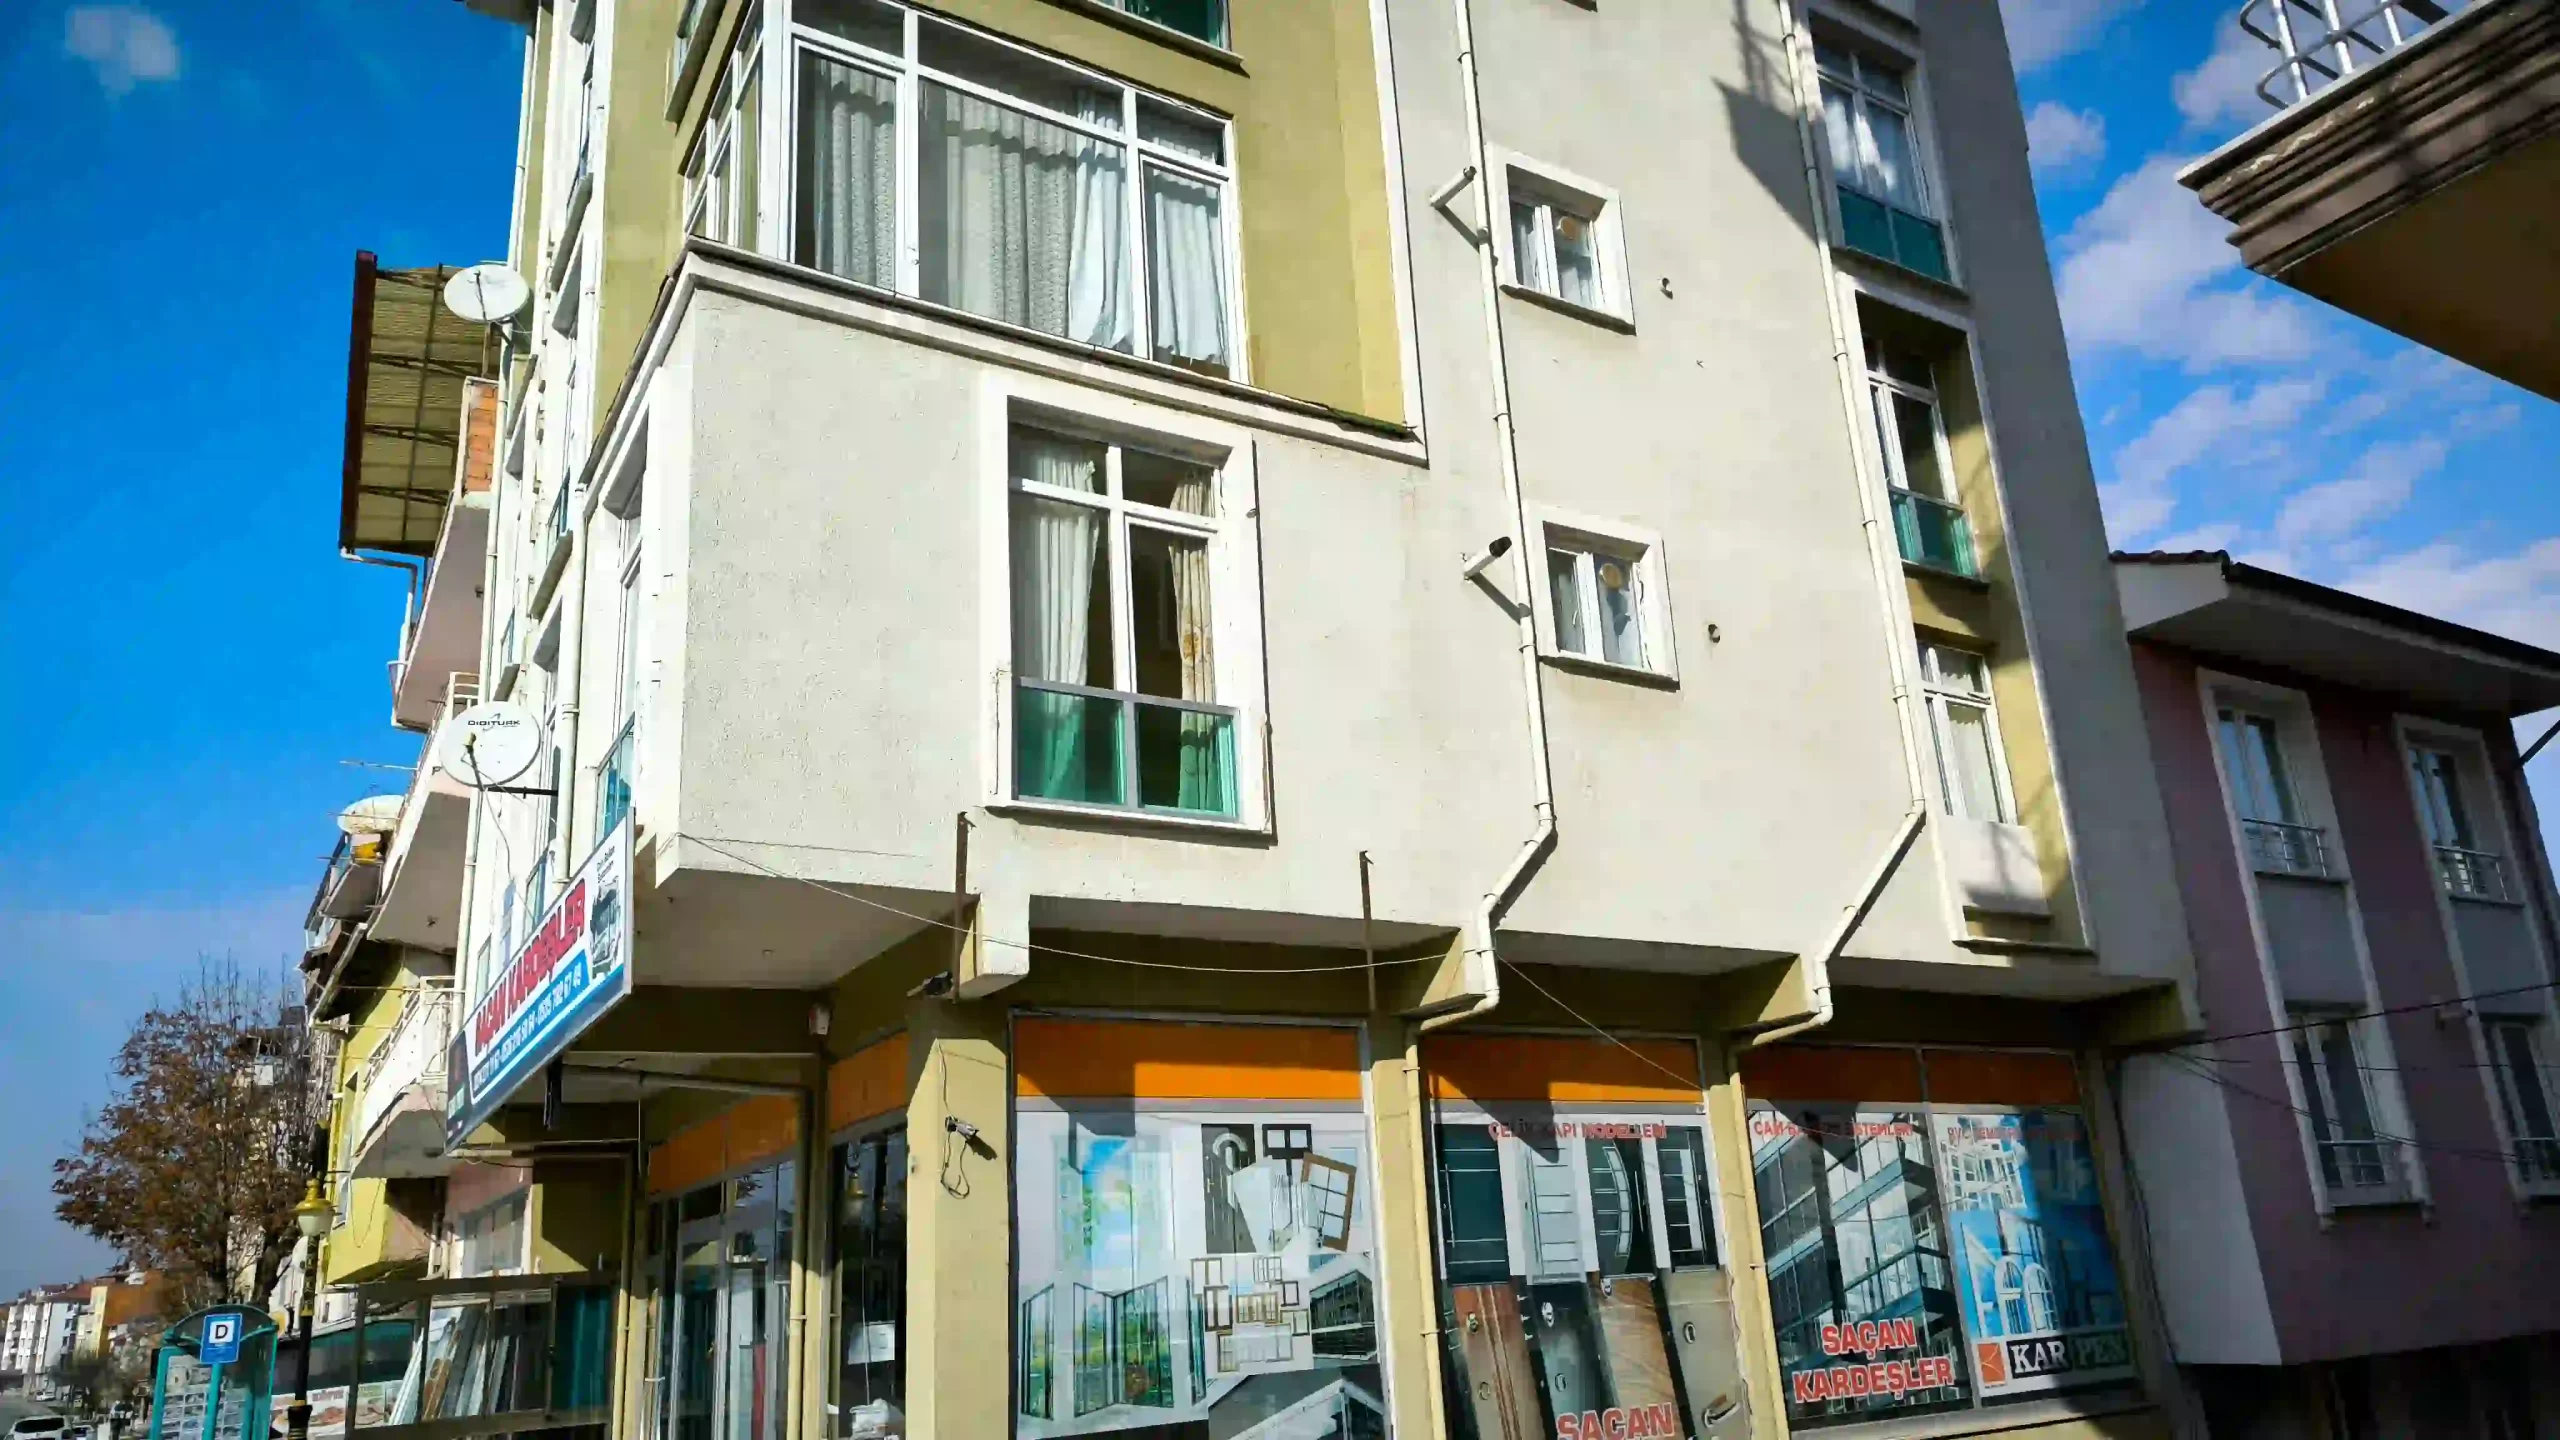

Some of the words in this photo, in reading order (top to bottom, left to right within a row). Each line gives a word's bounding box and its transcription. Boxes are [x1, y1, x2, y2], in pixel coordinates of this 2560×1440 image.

[215, 1324, 229, 1339] D
[1821, 1317, 1918, 1361] SAÇAN
[2010, 1340, 2069, 1374] KAR
[1792, 1356, 1955, 1404] KARDEŞLER
